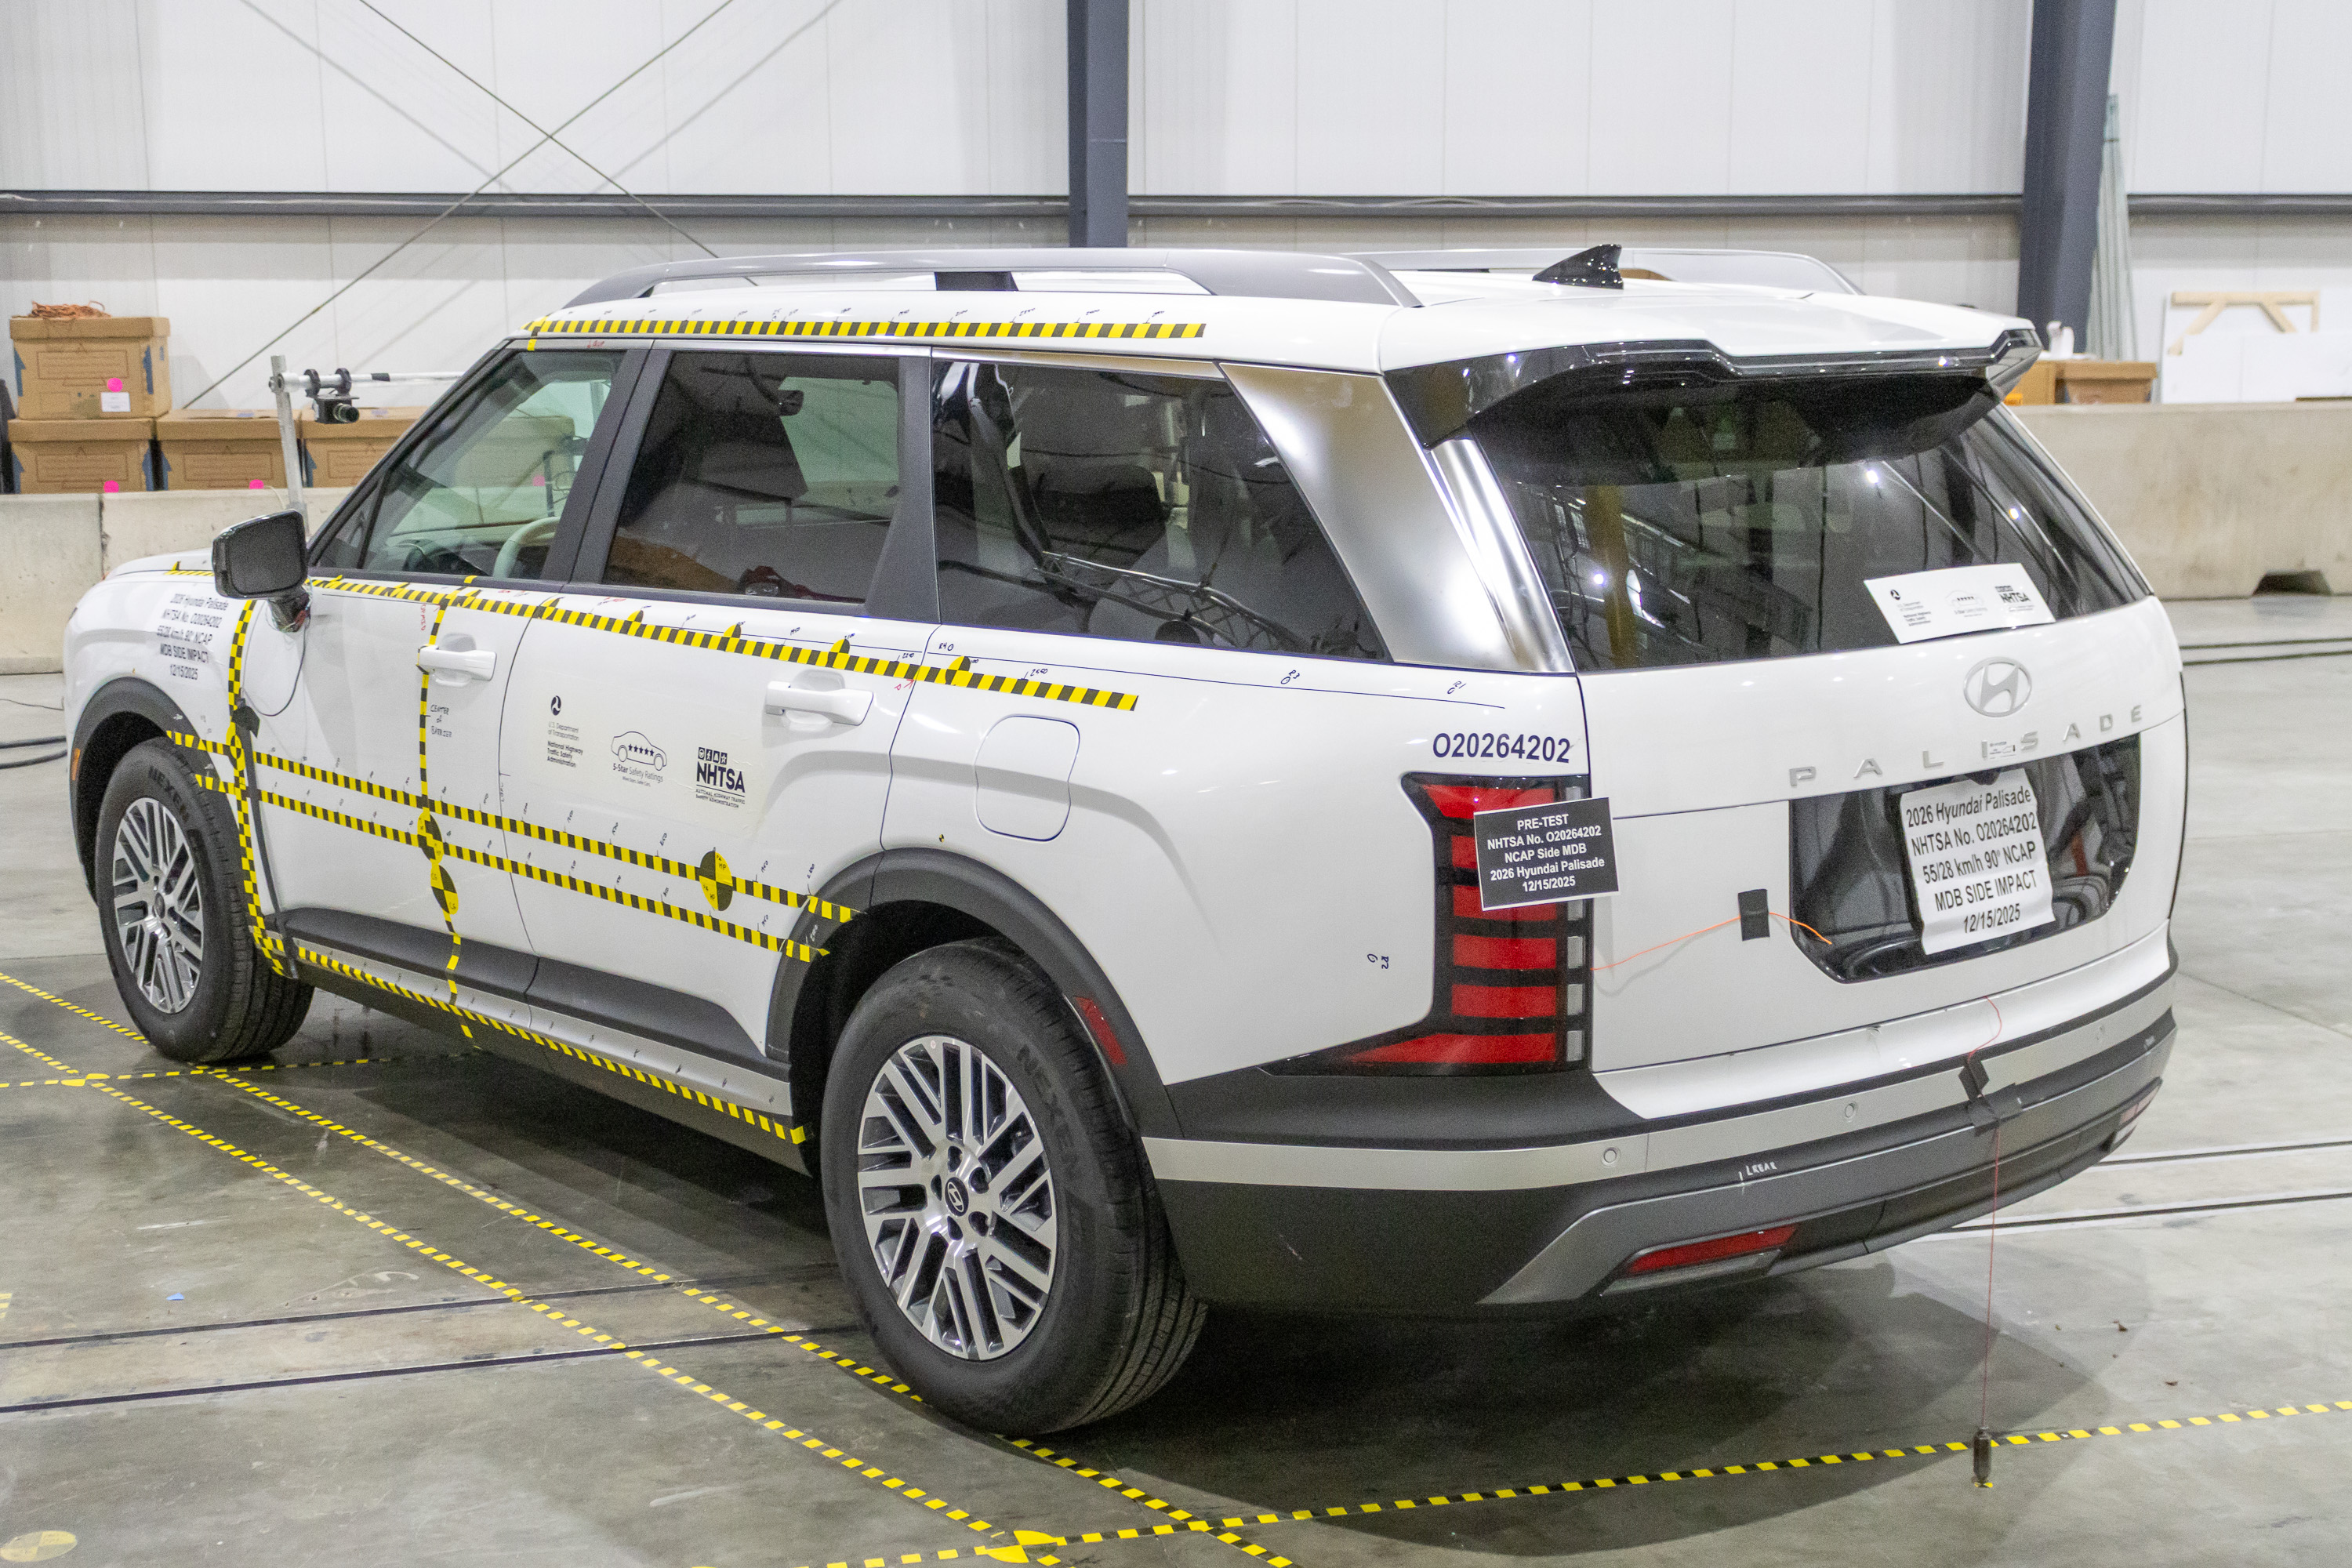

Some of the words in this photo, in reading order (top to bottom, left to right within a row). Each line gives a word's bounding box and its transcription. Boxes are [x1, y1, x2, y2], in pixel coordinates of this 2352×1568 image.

[565, 745, 583, 756] Highway
[1788, 704, 2143, 787] PALISADE
[612, 763, 628, 773] 5-Star
[629, 766, 644, 779] Safety
[644, 770, 663, 783] Ratings
[696, 760, 746, 793] NHTSA
[1906, 804, 1934, 828] 2026
[1936, 794, 1983, 825] Hyundai
[1985, 786, 2031, 811] Palisade
[1516, 813, 1570, 831] PRE-TEST
[1486, 835, 1525, 850] NHTSA
[1526, 833, 1544, 846] No.
[1504, 849, 1536, 863] NCAP
[1537, 847, 1560, 860] Side
[1562, 843, 1588, 856] MDB
[1911, 831, 1953, 857] NHTSA
[1954, 827, 1975, 848] No.
[1490, 868, 1515, 881] 2026
[1516, 862, 1559, 880] Hyundai
[1560, 856, 1606, 873] Palisade
[1922, 860, 1955, 884] 55/28
[1954, 854, 1984, 877] km/h
[2002, 840, 2036, 865] NCAP
[1522, 875, 1576, 892] 12/15/2025
[1934, 888, 1963, 912] MDB
[1965, 880, 1994, 904] SIDE
[1994, 869, 2037, 897] IMPACT
[1963, 903, 2020, 934] 12/15/2025
